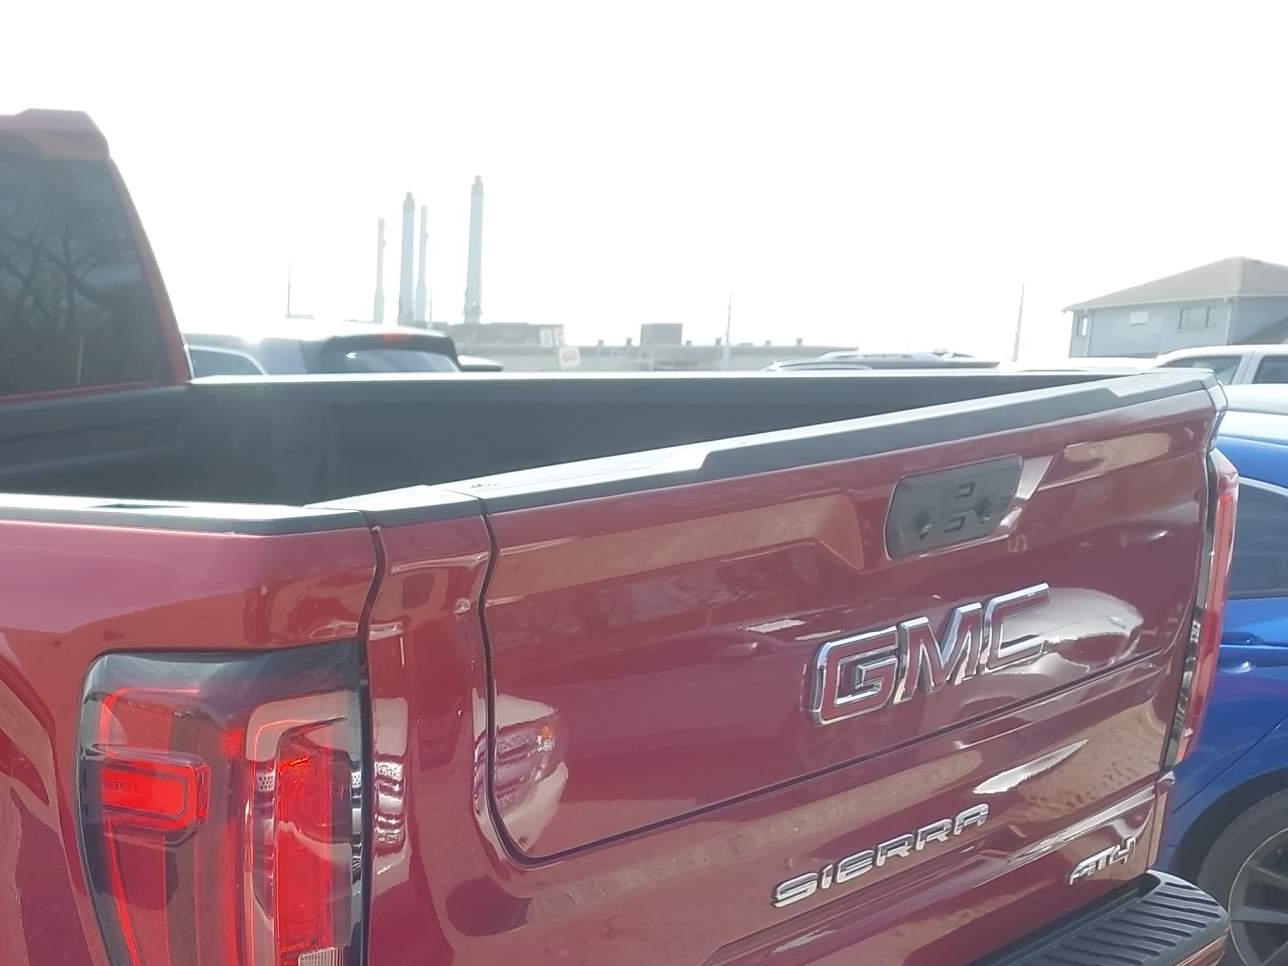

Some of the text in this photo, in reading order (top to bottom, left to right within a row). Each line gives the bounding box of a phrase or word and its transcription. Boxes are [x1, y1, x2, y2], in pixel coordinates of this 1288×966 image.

[811, 583, 1050, 726] GMC
[772, 803, 990, 907] SIERRA
[1069, 836, 1136, 886] AT4
